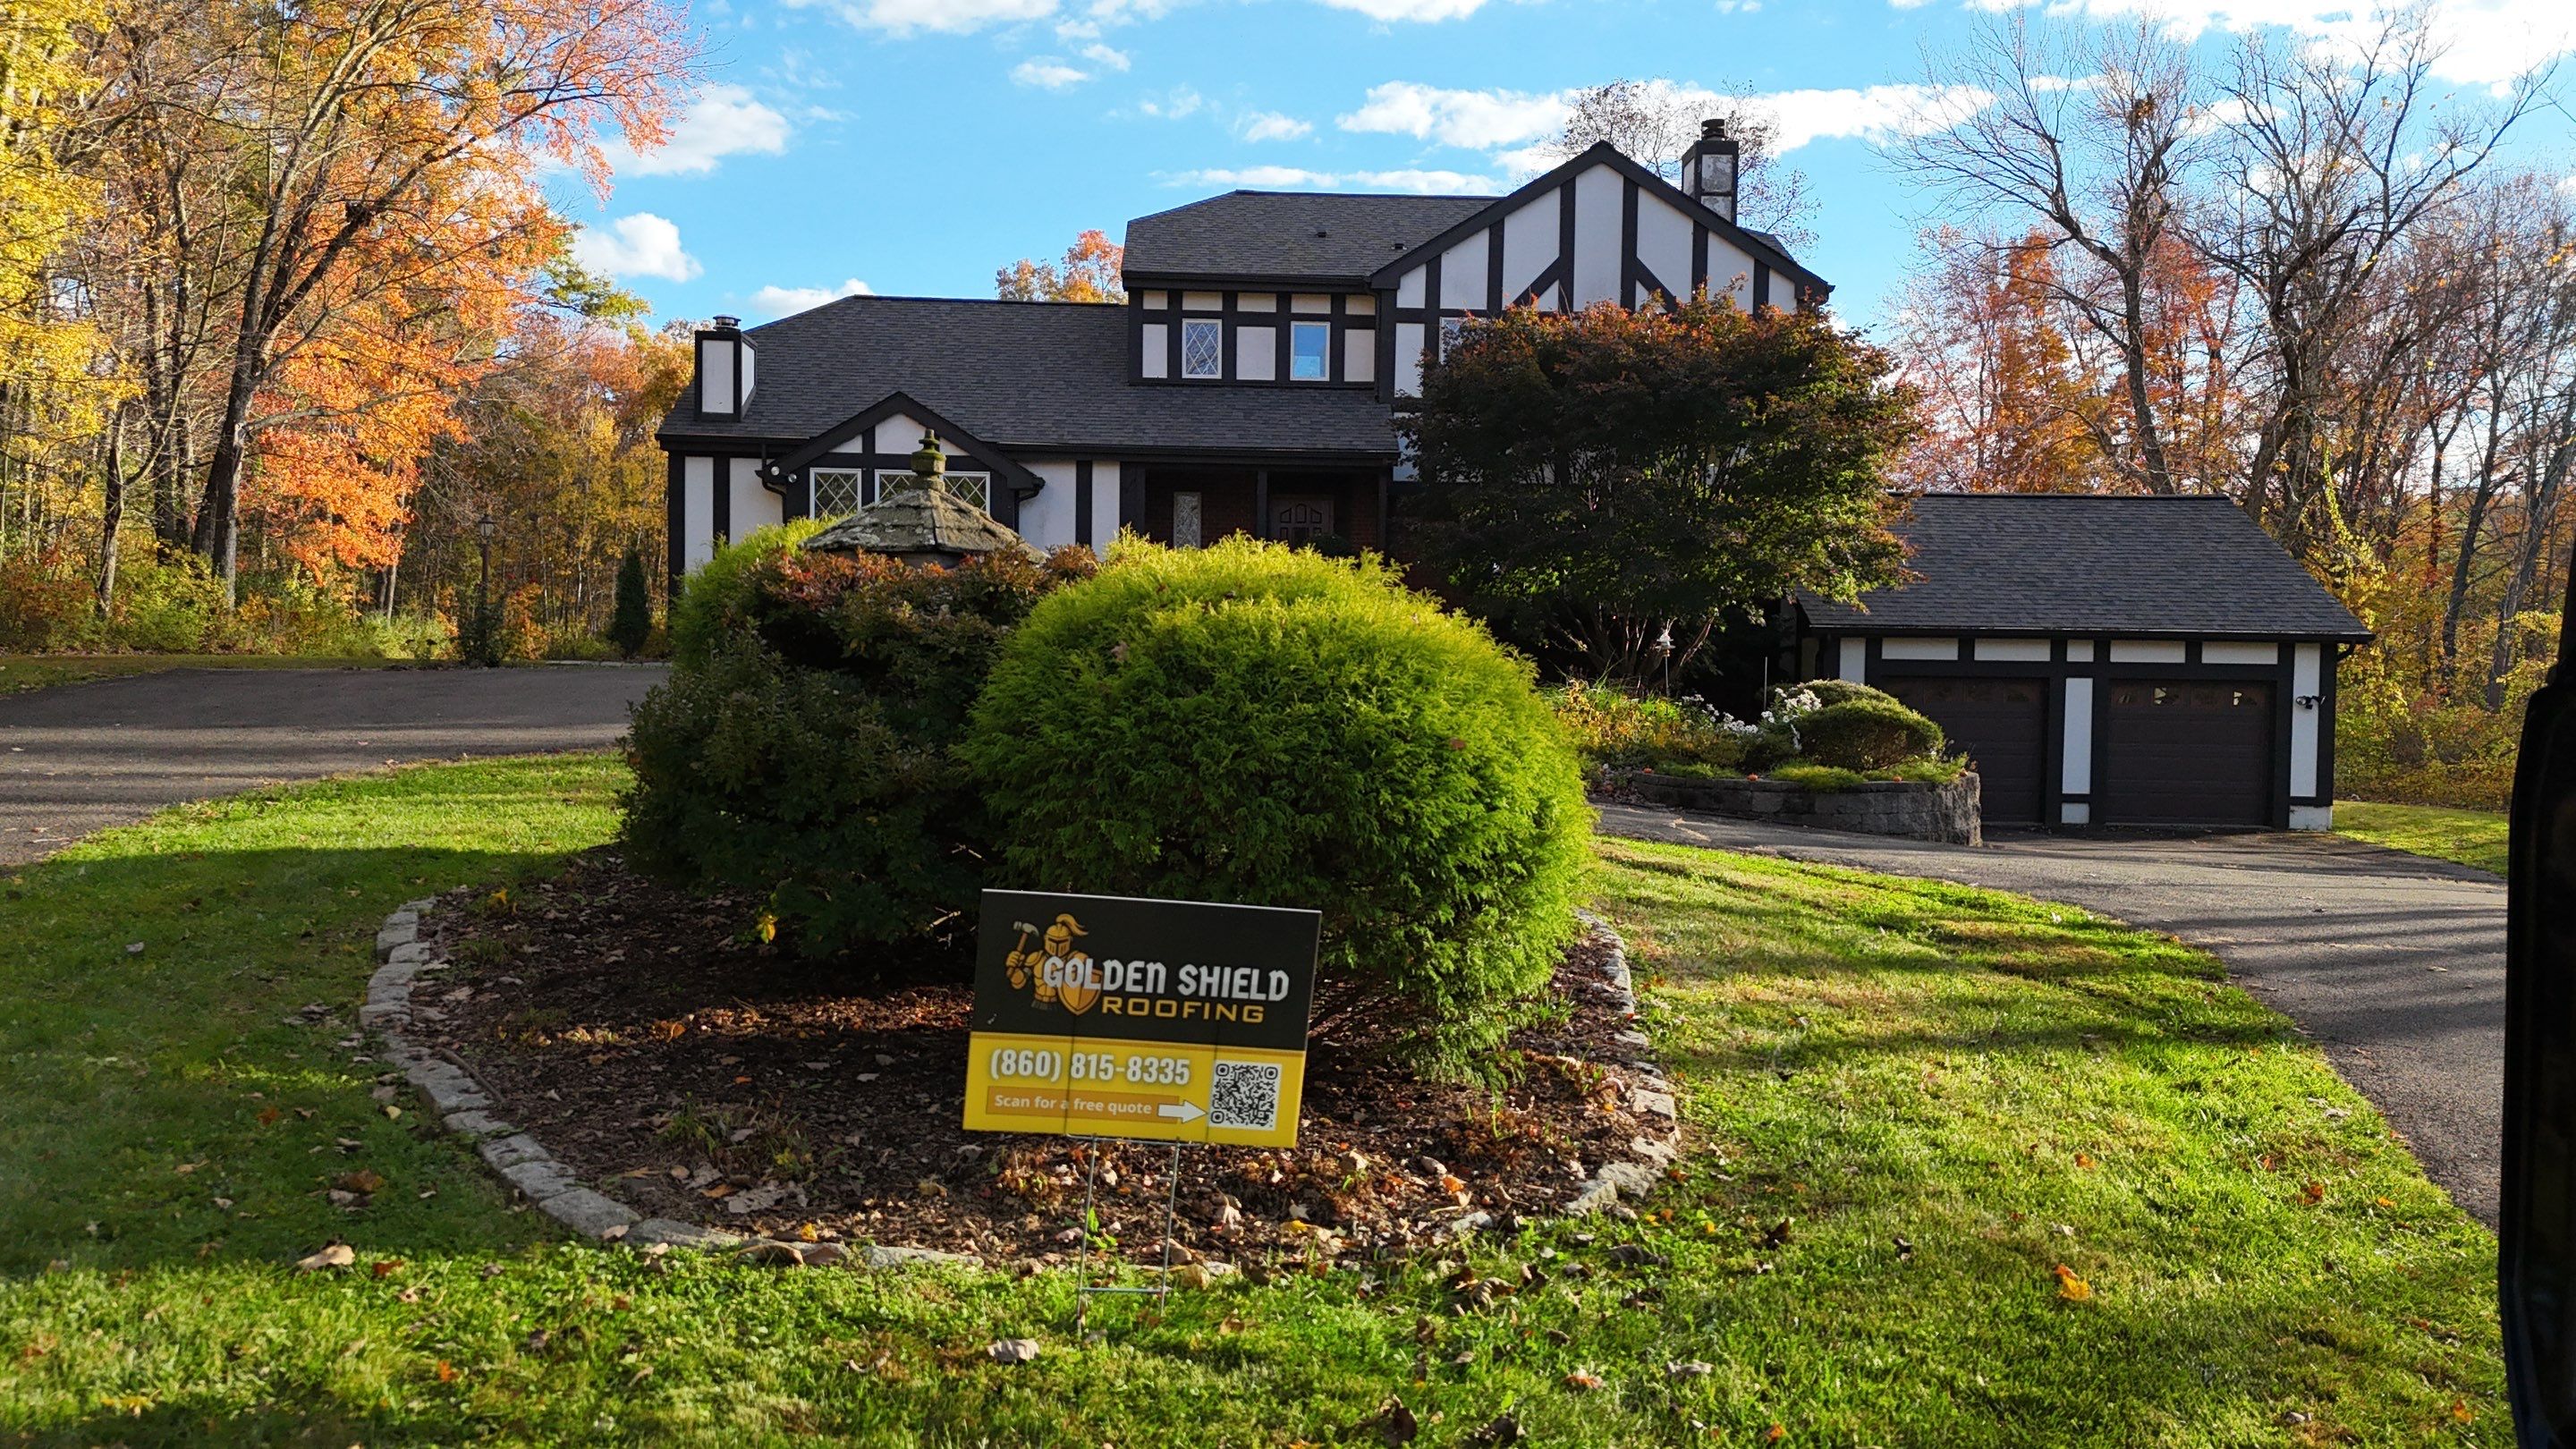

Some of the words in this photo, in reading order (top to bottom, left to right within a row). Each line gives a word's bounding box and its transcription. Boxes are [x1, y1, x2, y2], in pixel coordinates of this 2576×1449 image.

[1044, 956, 1165, 993] GOLDEN
[1178, 963, 1290, 1002] SHIELD
[1102, 996, 1265, 1023] ROOFING
[990, 1048, 1062, 1082] (860)
[1071, 1053, 1191, 1086] 815-8335
[995, 1094, 1030, 1109] Scan
[1034, 1095, 1055, 1109] for
[1059, 1100, 1068, 1109] a
[1073, 1097, 1105, 1112] free
[1109, 1101, 1152, 1115] quote
